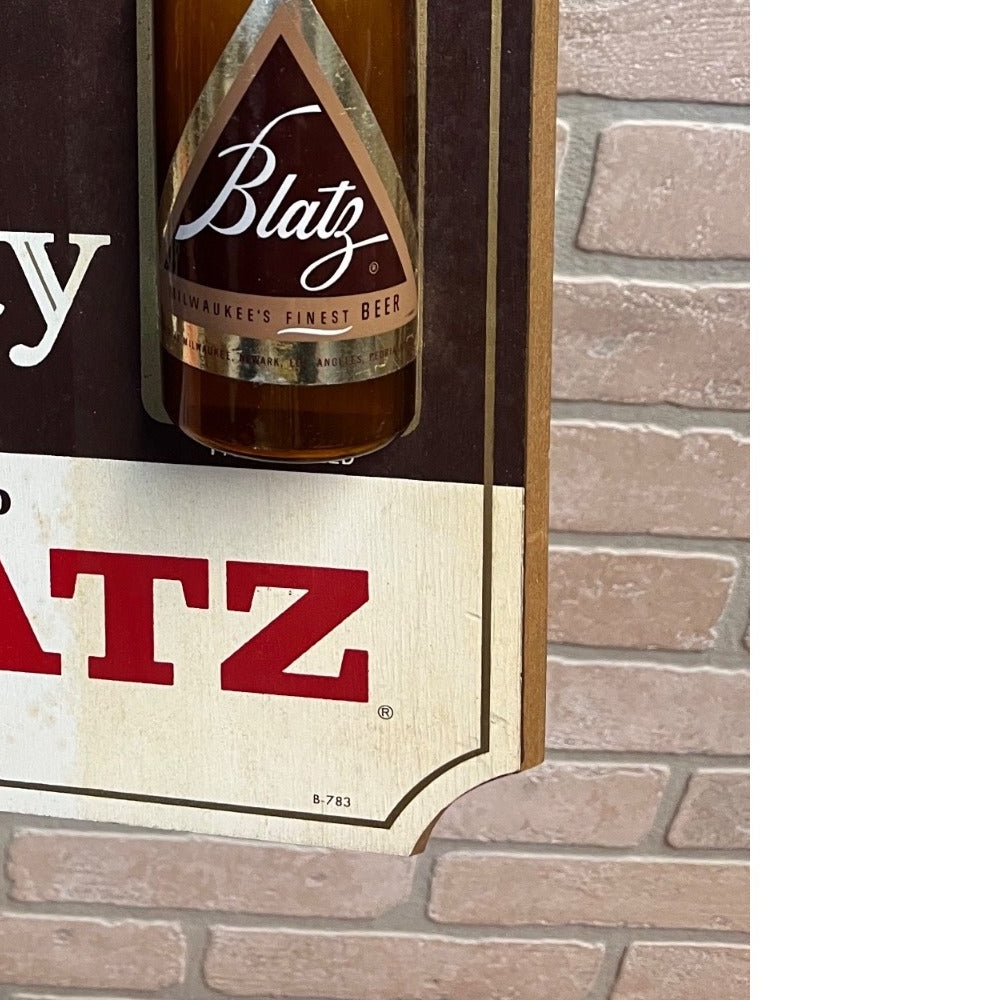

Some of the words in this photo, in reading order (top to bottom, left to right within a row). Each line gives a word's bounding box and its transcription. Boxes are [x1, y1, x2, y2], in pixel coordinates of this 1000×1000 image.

[174, 104, 389, 292] Blatz
[286, 309, 349, 325] FINEST
[361, 293, 400, 321] BEER
[313, 793, 351, 808] B-783
